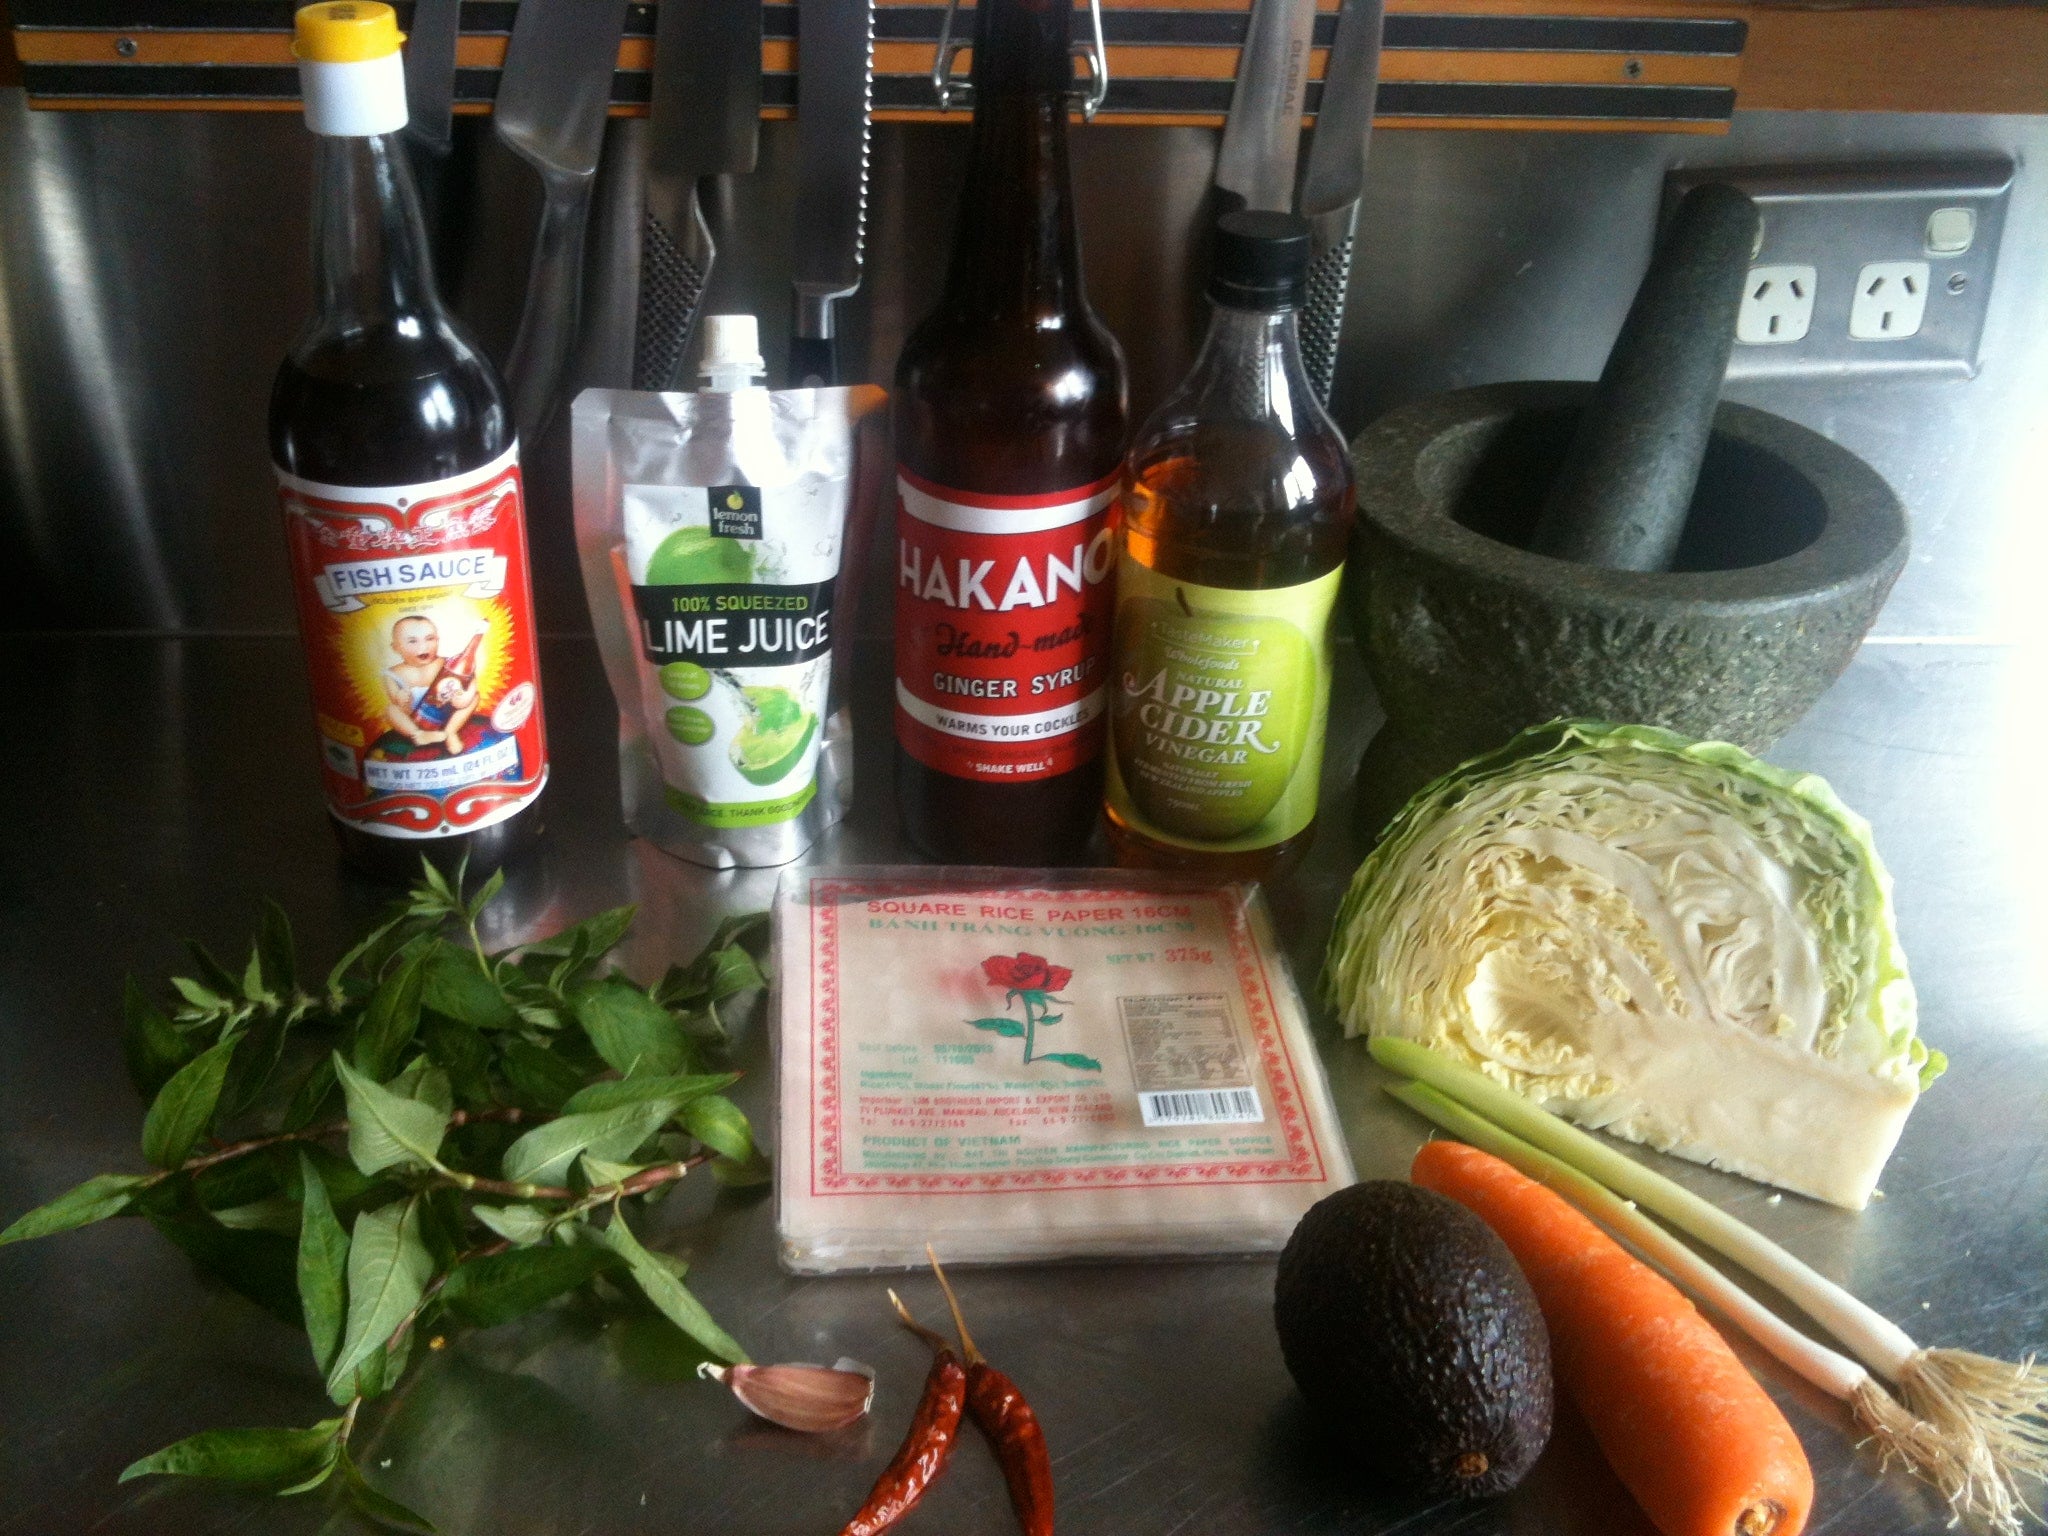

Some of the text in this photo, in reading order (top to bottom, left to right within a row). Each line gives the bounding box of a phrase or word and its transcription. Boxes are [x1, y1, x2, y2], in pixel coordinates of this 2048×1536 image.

[713, 507, 758, 522] lemon
[717, 521, 755, 536] fresh
[332, 555, 486, 590] FISH SAUCE
[672, 596, 808, 612] 100% SQUEEZED
[643, 610, 830, 654] LIME JUICE
[935, 612, 1091, 659] Hand-mad
[933, 655, 1096, 698] GINGER SYRUP
[1177, 671, 1244, 689] NATURAL
[1123, 668, 1273, 717] APPLE
[935, 705, 1089, 737] WARMS YOUR COCKLES
[1140, 704, 1281, 754] CIDER
[1146, 732, 1248, 765] VINEGAR
[417, 768, 438, 780] 725
[975, 760, 1045, 774] SHAKE WELL
[867, 901, 967, 916] SQUARE
[980, 905, 1034, 921] RICE
[1047, 907, 1125, 922] PAPER
[1164, 947, 1214, 965] 375g
[863, 1135, 1021, 1148] PRODUCT OF VIETNAM
